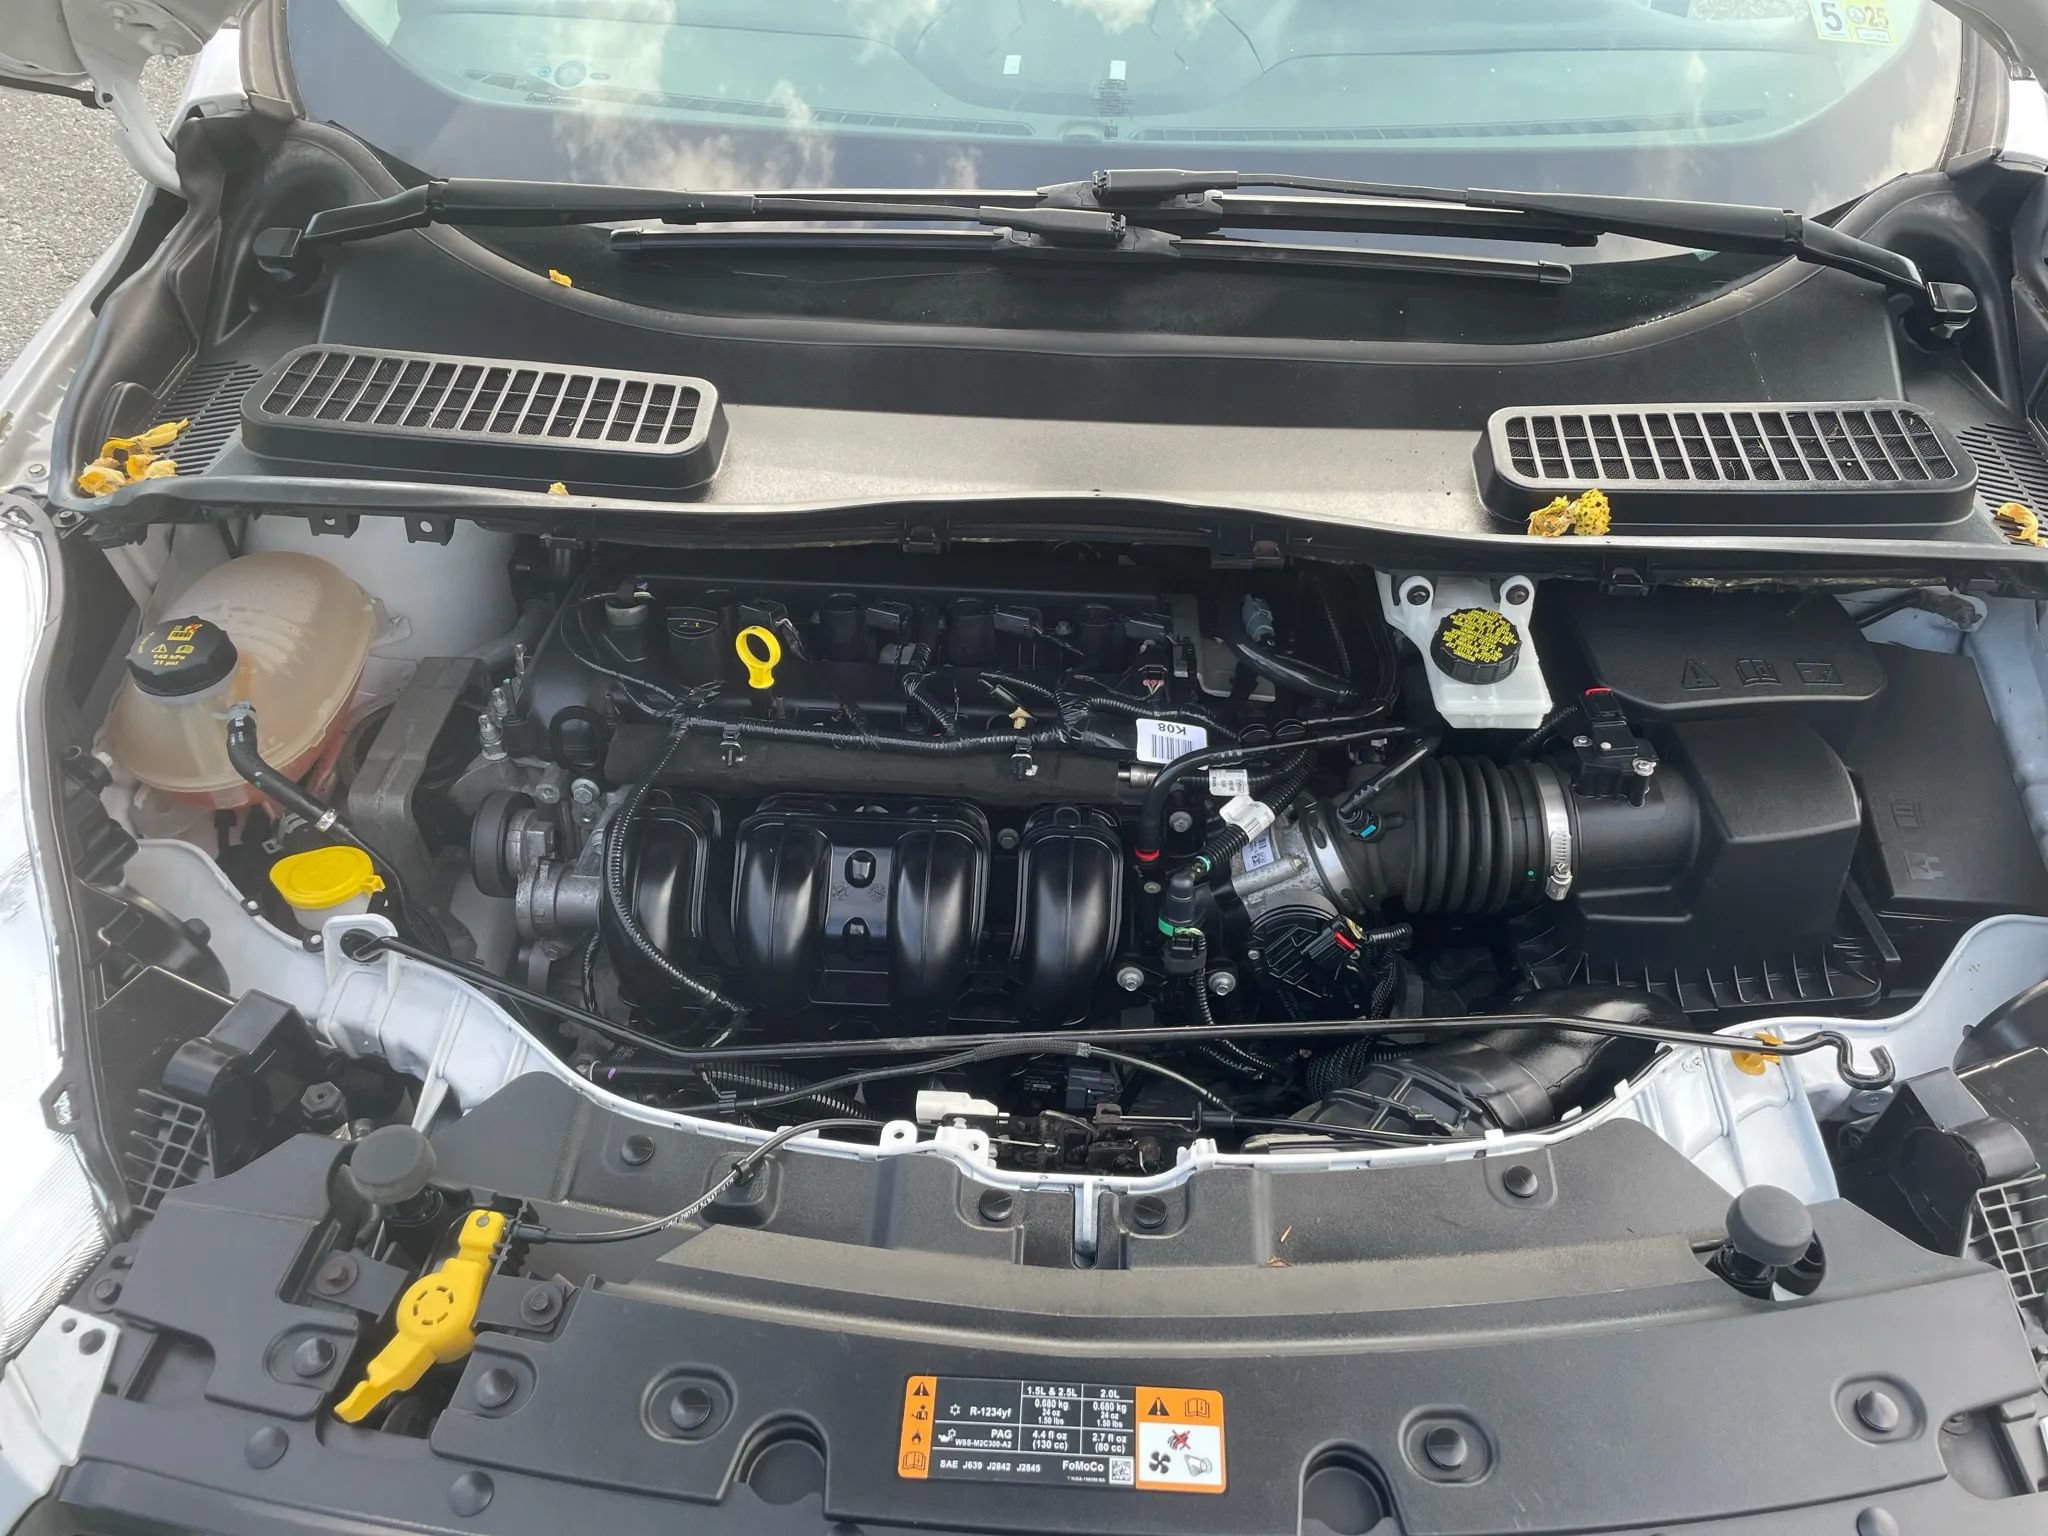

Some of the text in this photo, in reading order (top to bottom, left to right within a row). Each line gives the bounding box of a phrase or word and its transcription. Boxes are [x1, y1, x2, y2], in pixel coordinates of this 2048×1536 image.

[1820, 2, 1889, 31] 5 25
[1158, 722, 1187, 736] K08
[1027, 1385, 1078, 1397] 1.5L & 2.5L
[1100, 1389, 1120, 1399] 2.0L
[1034, 1398, 1069, 1411] 0.680 kg
[1093, 1401, 1128, 1415] 0.680 kg
[969, 1405, 1013, 1420] R-1234yf
[1042, 1408, 1061, 1417] 24 oz
[1100, 1411, 1120, 1421] 24 oz
[1038, 1416, 1065, 1426] 1.50 lbs
[1096, 1418, 1124, 1429] 1.50 lbs
[990, 1428, 1013, 1440] PAG
[1032, 1429, 1068, 1441] 4.4 fl oz
[1092, 1432, 1127, 1444] 2.7 fl oz
[1032, 1439, 1069, 1452] (130 cc)
[1094, 1442, 1126, 1455] (80 cc)
[939, 1459, 1041, 1473] SAE J639 J2842 J2845
[1062, 1460, 1105, 1472] FoMoCo
